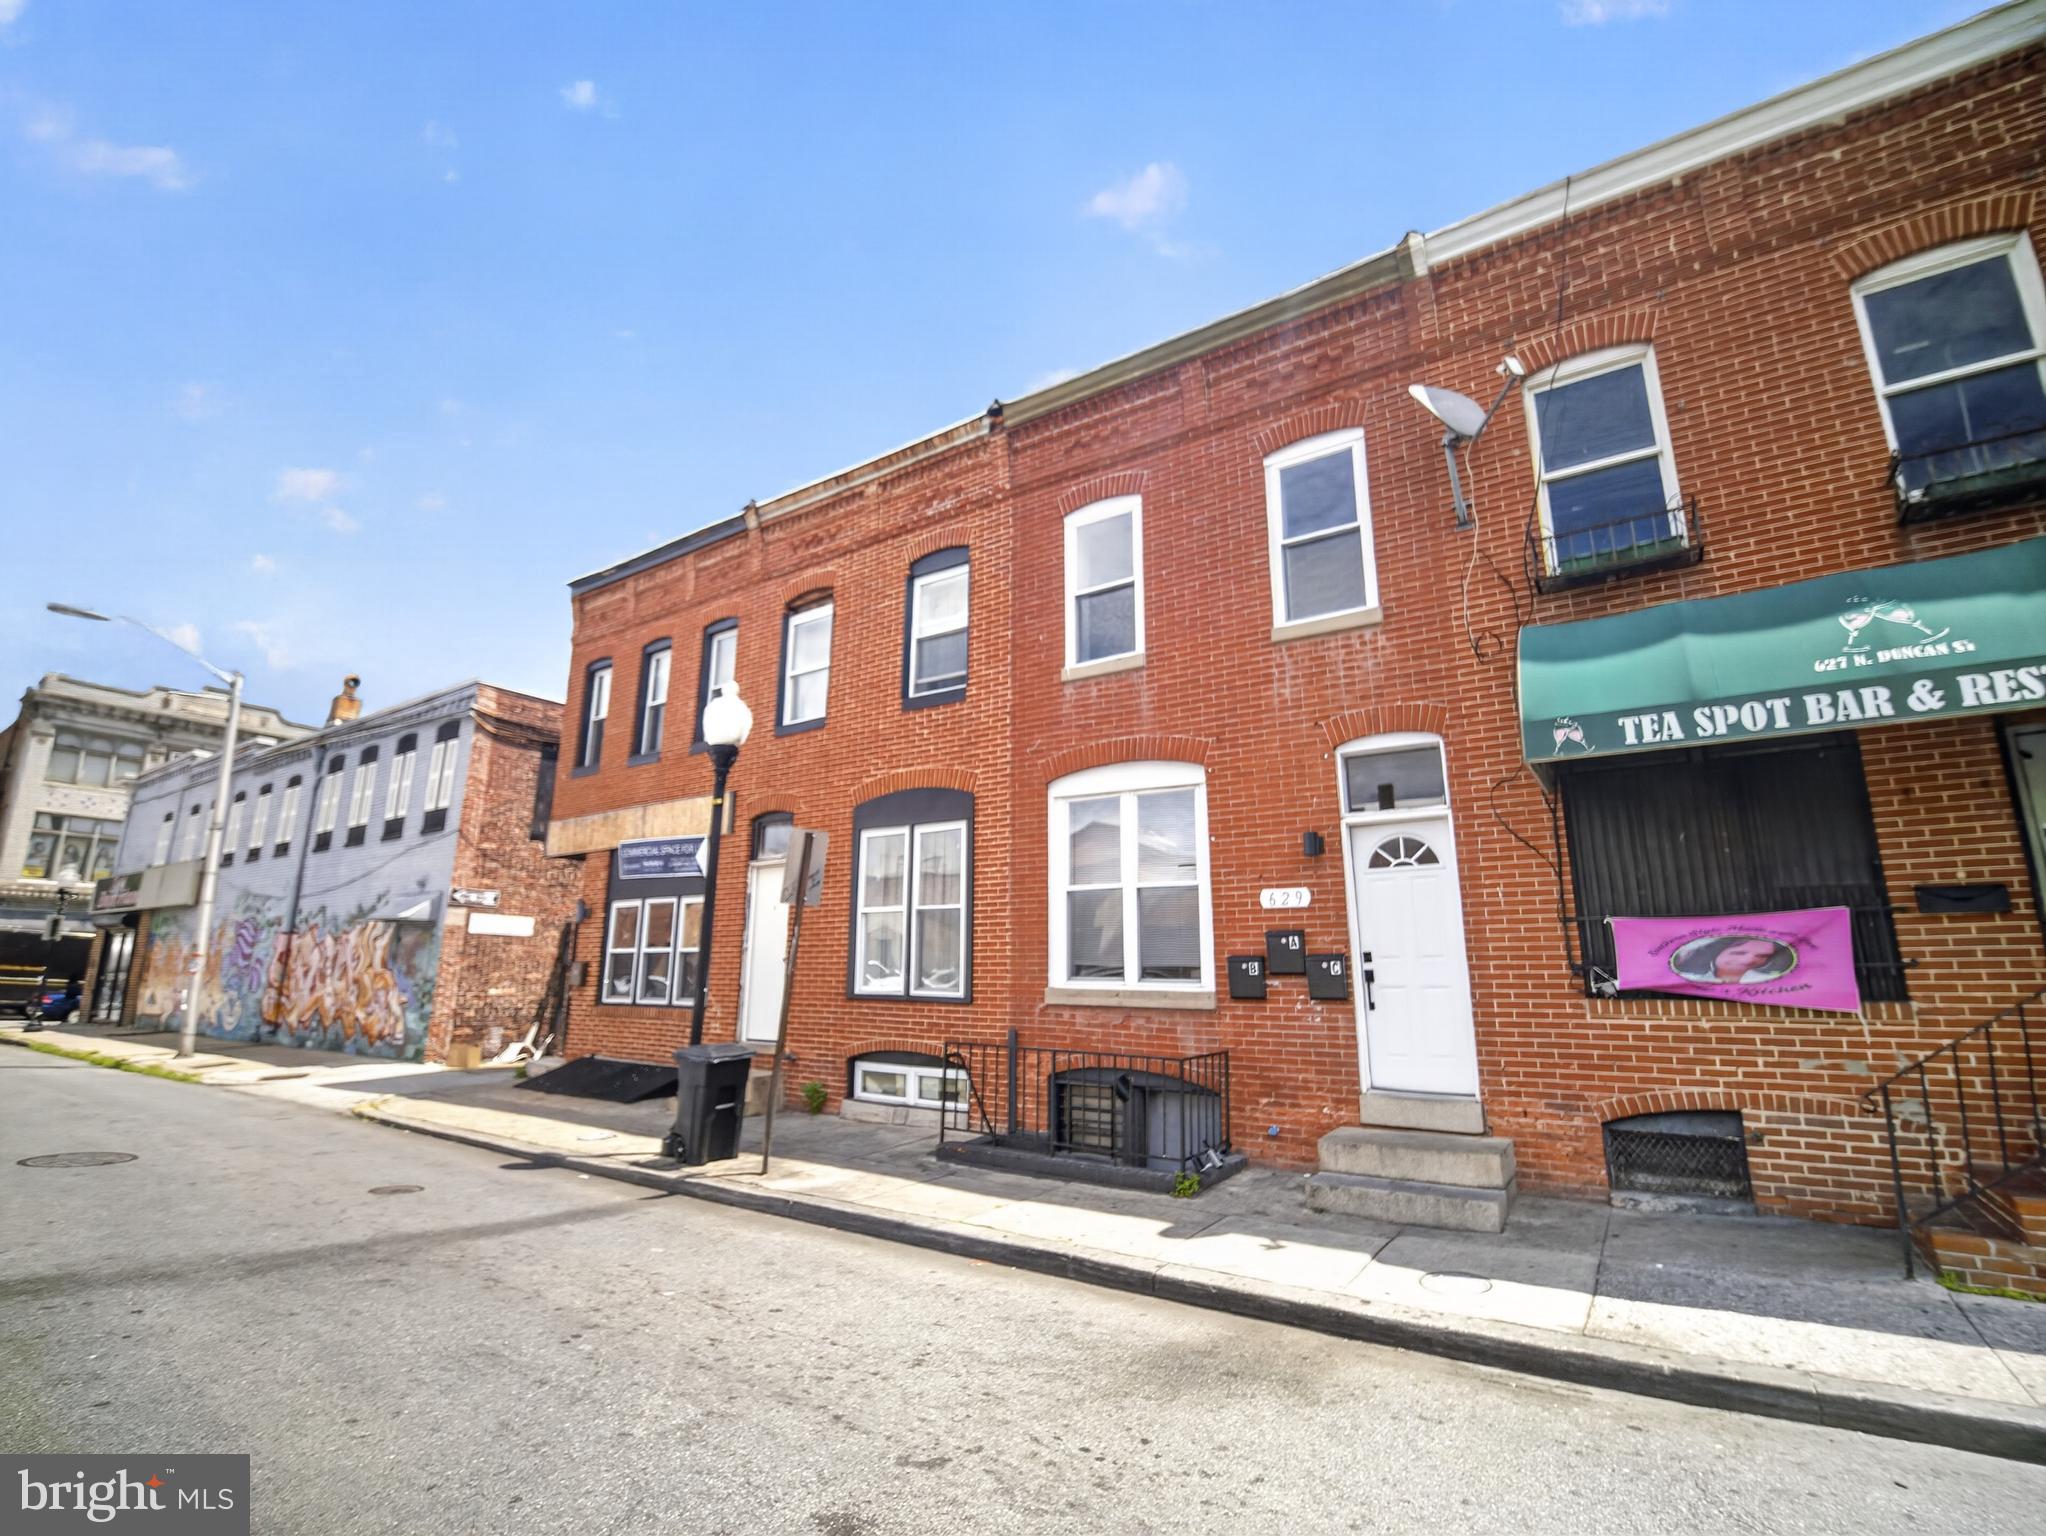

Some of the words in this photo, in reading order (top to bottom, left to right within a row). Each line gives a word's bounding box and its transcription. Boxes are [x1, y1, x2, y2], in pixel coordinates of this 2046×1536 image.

[1814, 656, 1848, 673] 627
[1853, 653, 1874, 667] N.
[1876, 643, 1949, 663] DUNCAN
[1618, 710, 1685, 746] TEA
[1693, 696, 1792, 738] SPOT
[1802, 685, 1896, 726] BAR
[1906, 678, 1946, 712] &
[1957, 664, 2046, 707] RES
[1269, 891, 1303, 907] 629
